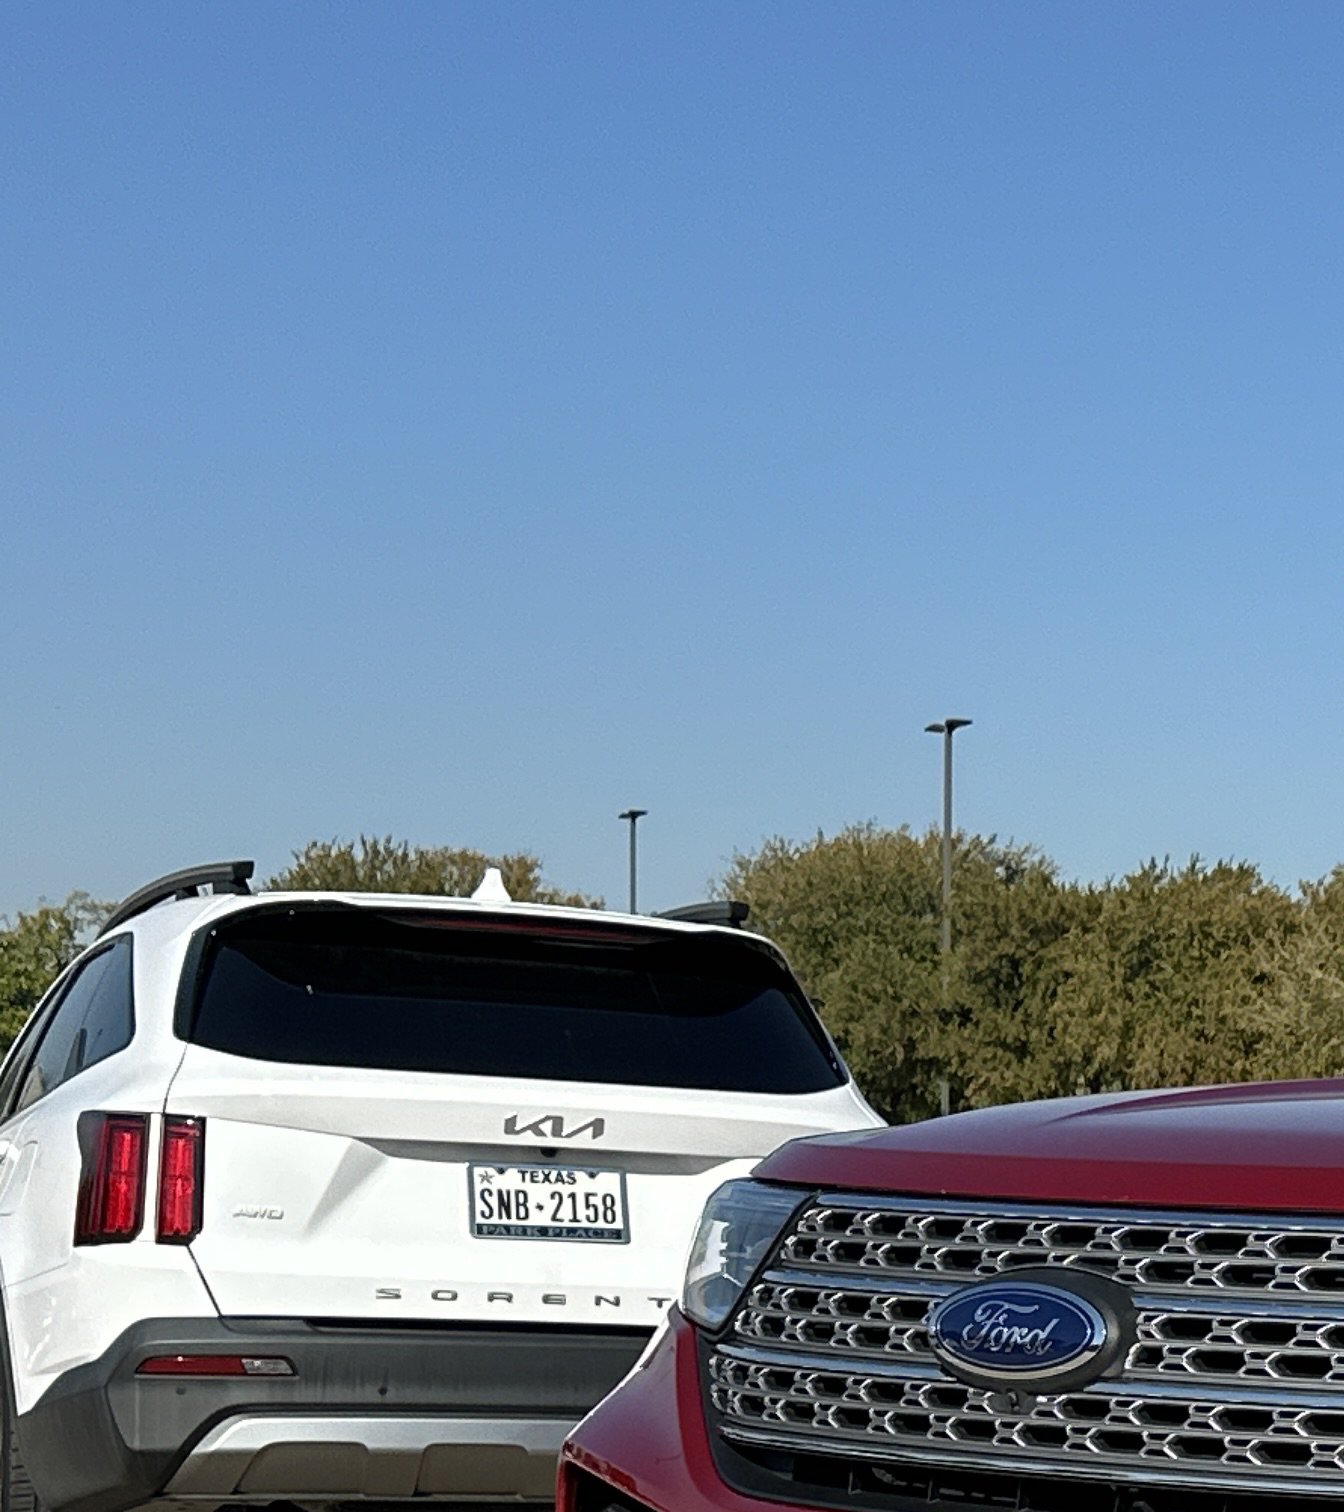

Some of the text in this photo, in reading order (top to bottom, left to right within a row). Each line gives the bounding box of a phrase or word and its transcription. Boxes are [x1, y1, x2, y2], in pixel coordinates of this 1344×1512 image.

[504, 1114, 605, 1140] KIA
[518, 1170, 577, 1185] TEXAS
[480, 1188, 616, 1224] SNB 2158
[376, 1288, 672, 1308] SORENT
[961, 1300, 1061, 1356] Ford
